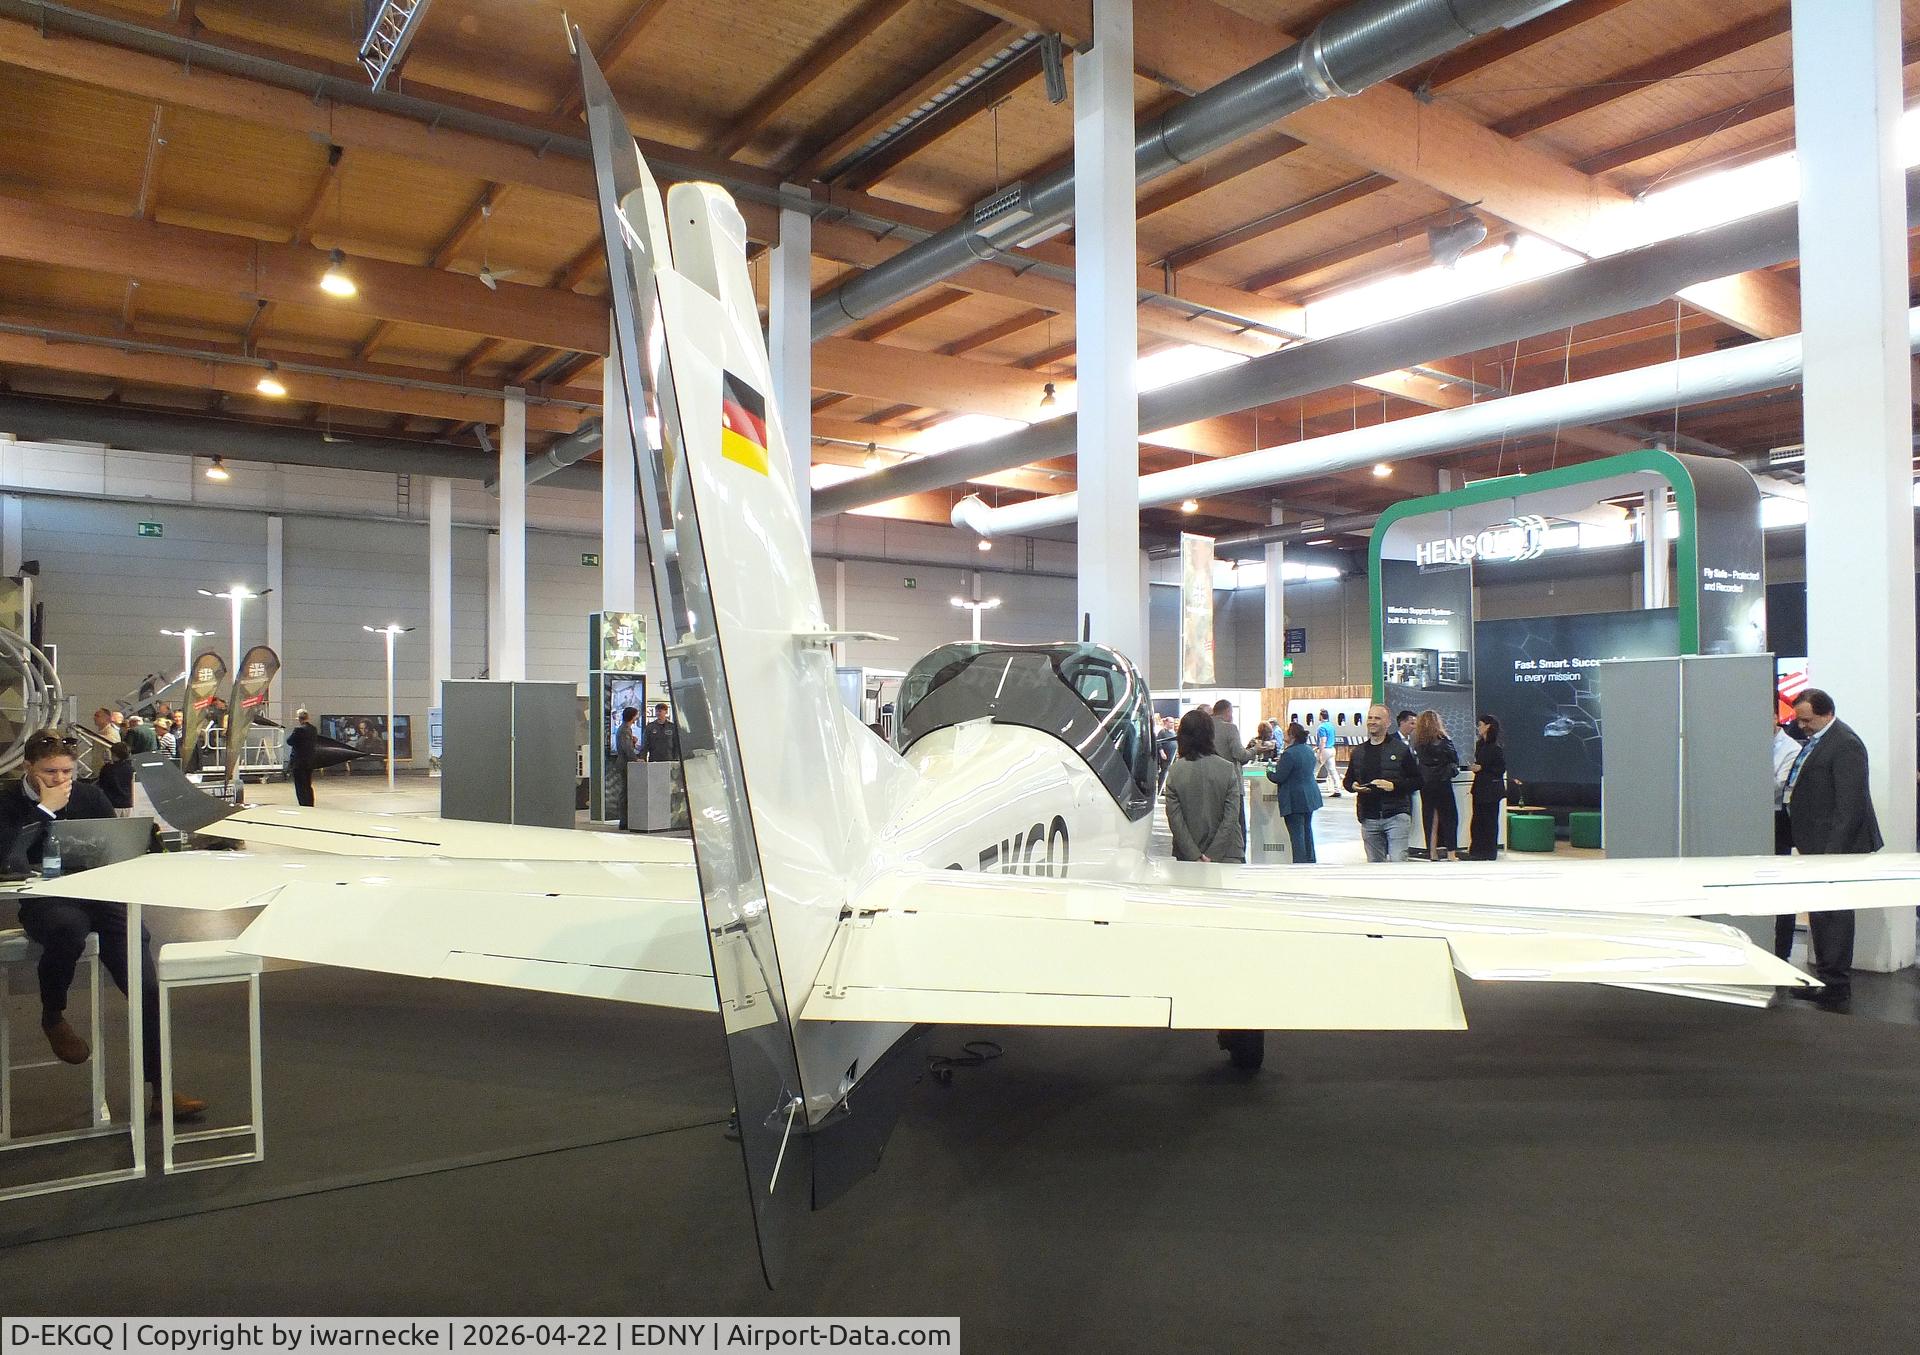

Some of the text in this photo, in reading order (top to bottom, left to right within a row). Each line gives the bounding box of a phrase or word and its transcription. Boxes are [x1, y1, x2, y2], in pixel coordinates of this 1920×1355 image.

[1416, 523, 1543, 566] HENSO
[1514, 660, 1537, 670] Fast.
[1538, 659, 1570, 669] Smart.
[1514, 672, 1581, 684] in every mission
